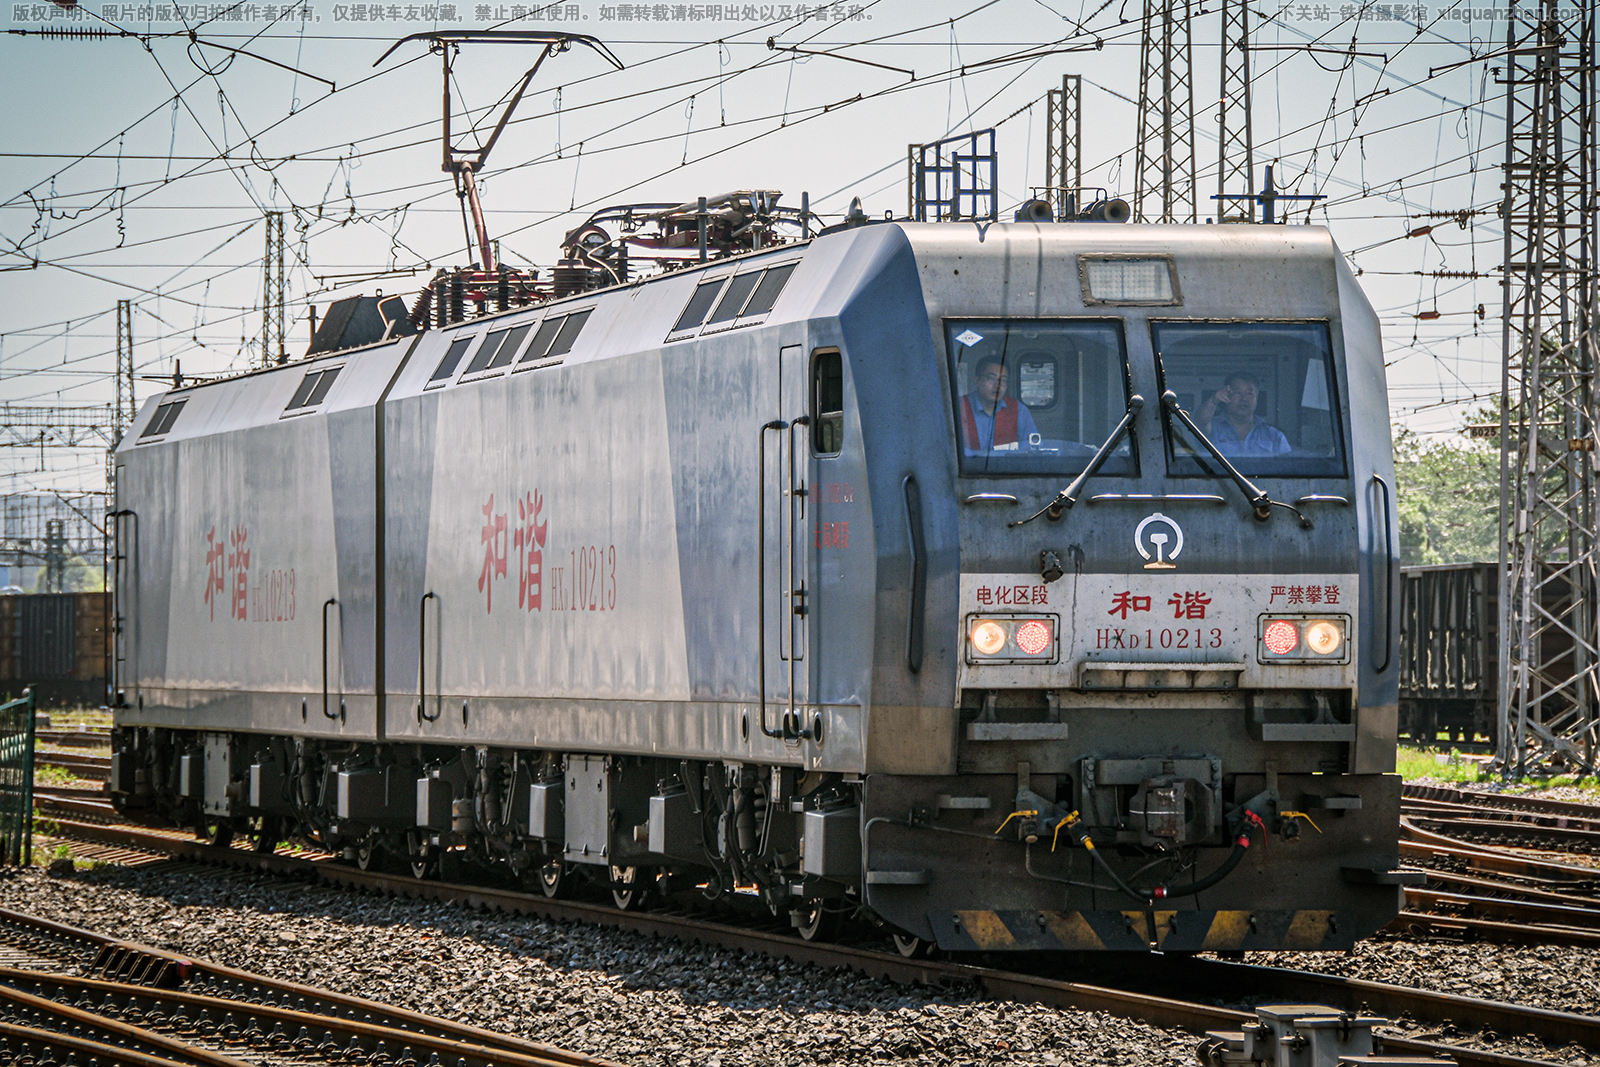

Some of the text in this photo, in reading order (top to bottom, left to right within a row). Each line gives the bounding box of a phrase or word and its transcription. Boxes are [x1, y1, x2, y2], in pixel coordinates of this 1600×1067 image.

[1472, 428, 1497, 437] 6025
[478, 487, 548, 615] 和谐
[204, 524, 251, 622] 和谐
[976, 585, 1048, 606] 电化区段
[1107, 591, 1212, 620] 和谐
[1269, 585, 1341, 605] 严禁攀登
